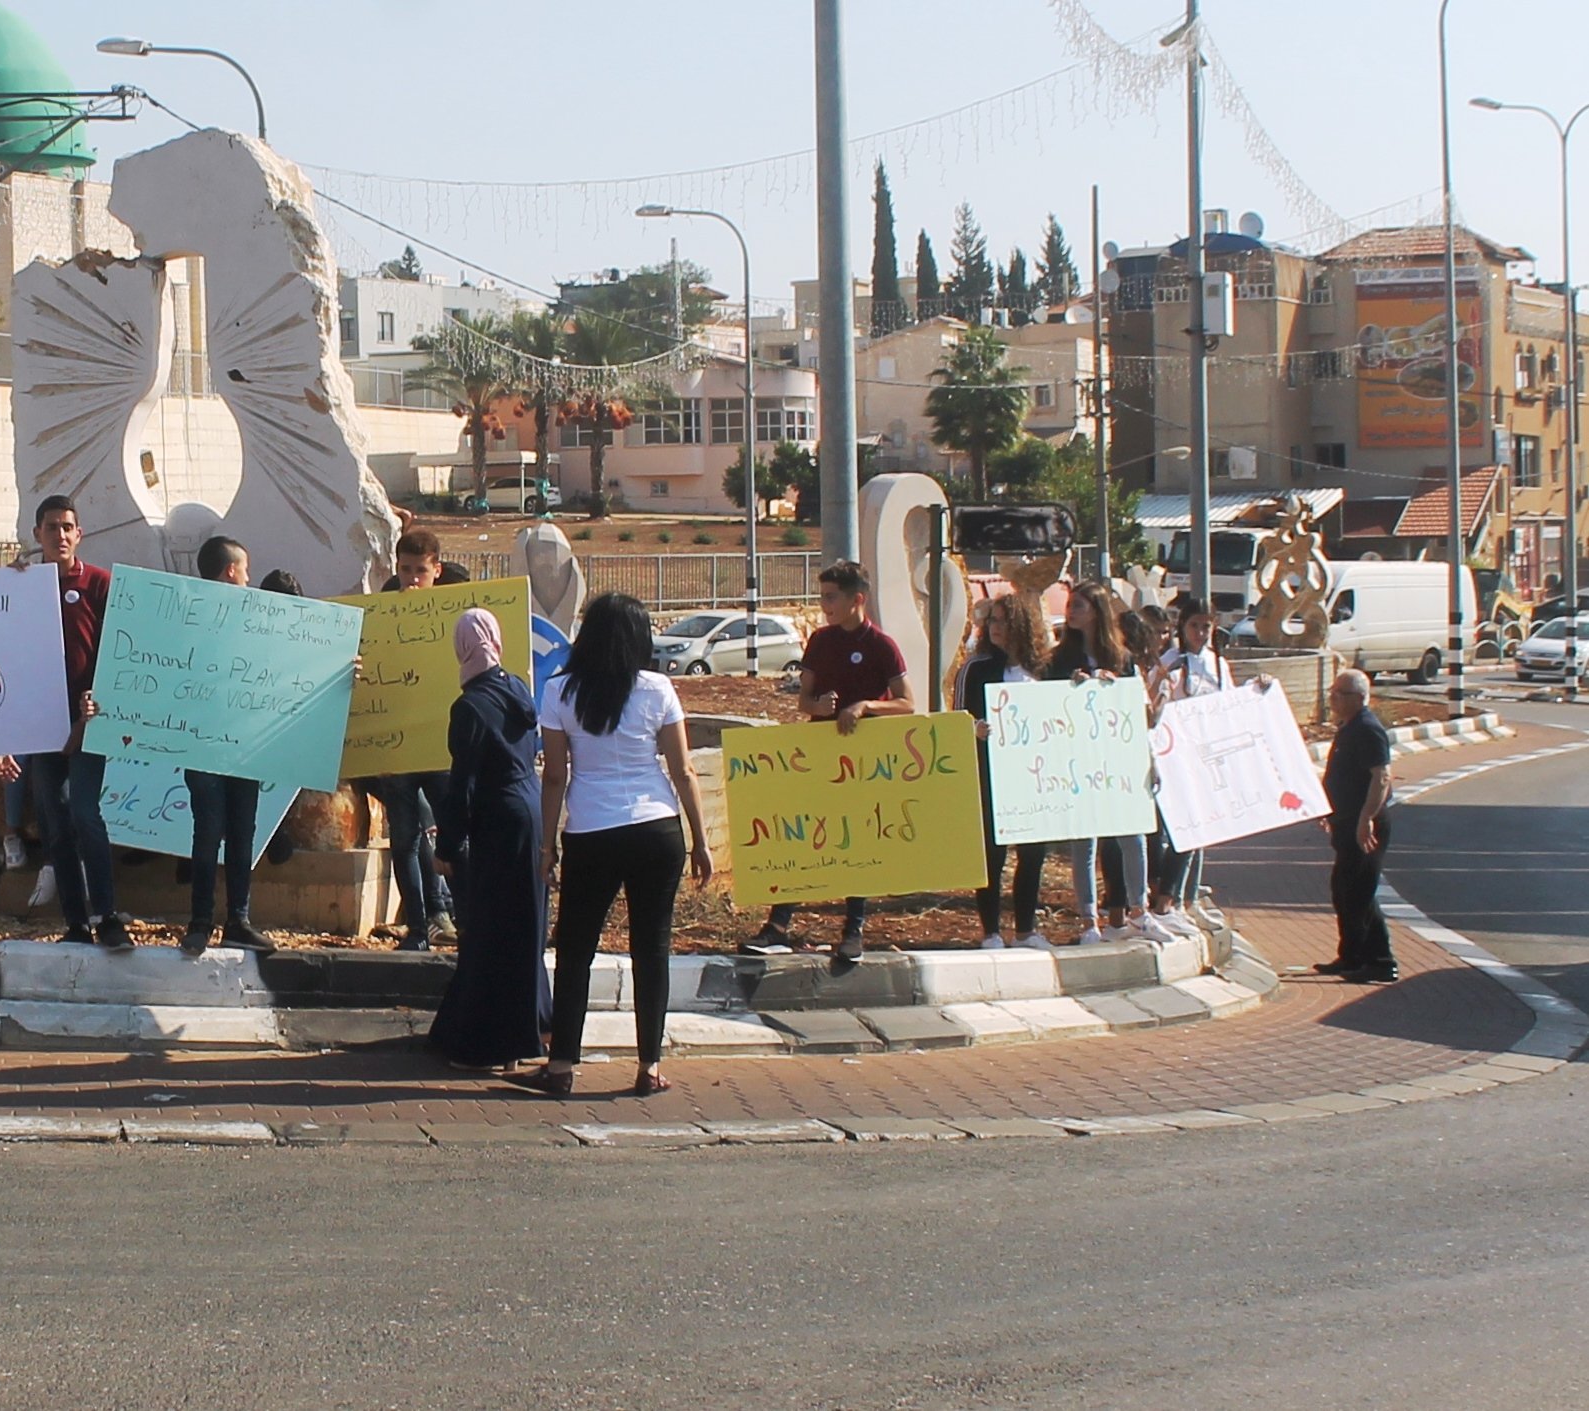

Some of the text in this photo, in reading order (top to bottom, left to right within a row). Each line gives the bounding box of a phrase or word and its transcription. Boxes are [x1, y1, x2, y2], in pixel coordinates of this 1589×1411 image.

[150, 581, 204, 626] TIME
[113, 670, 158, 694] END
[173, 679, 218, 702] GUN
[114, 629, 316, 694] Demand a PLAN to
[728, 724, 958, 784] אלימות גורמת
[740, 798, 919, 850] לאי נעימות
